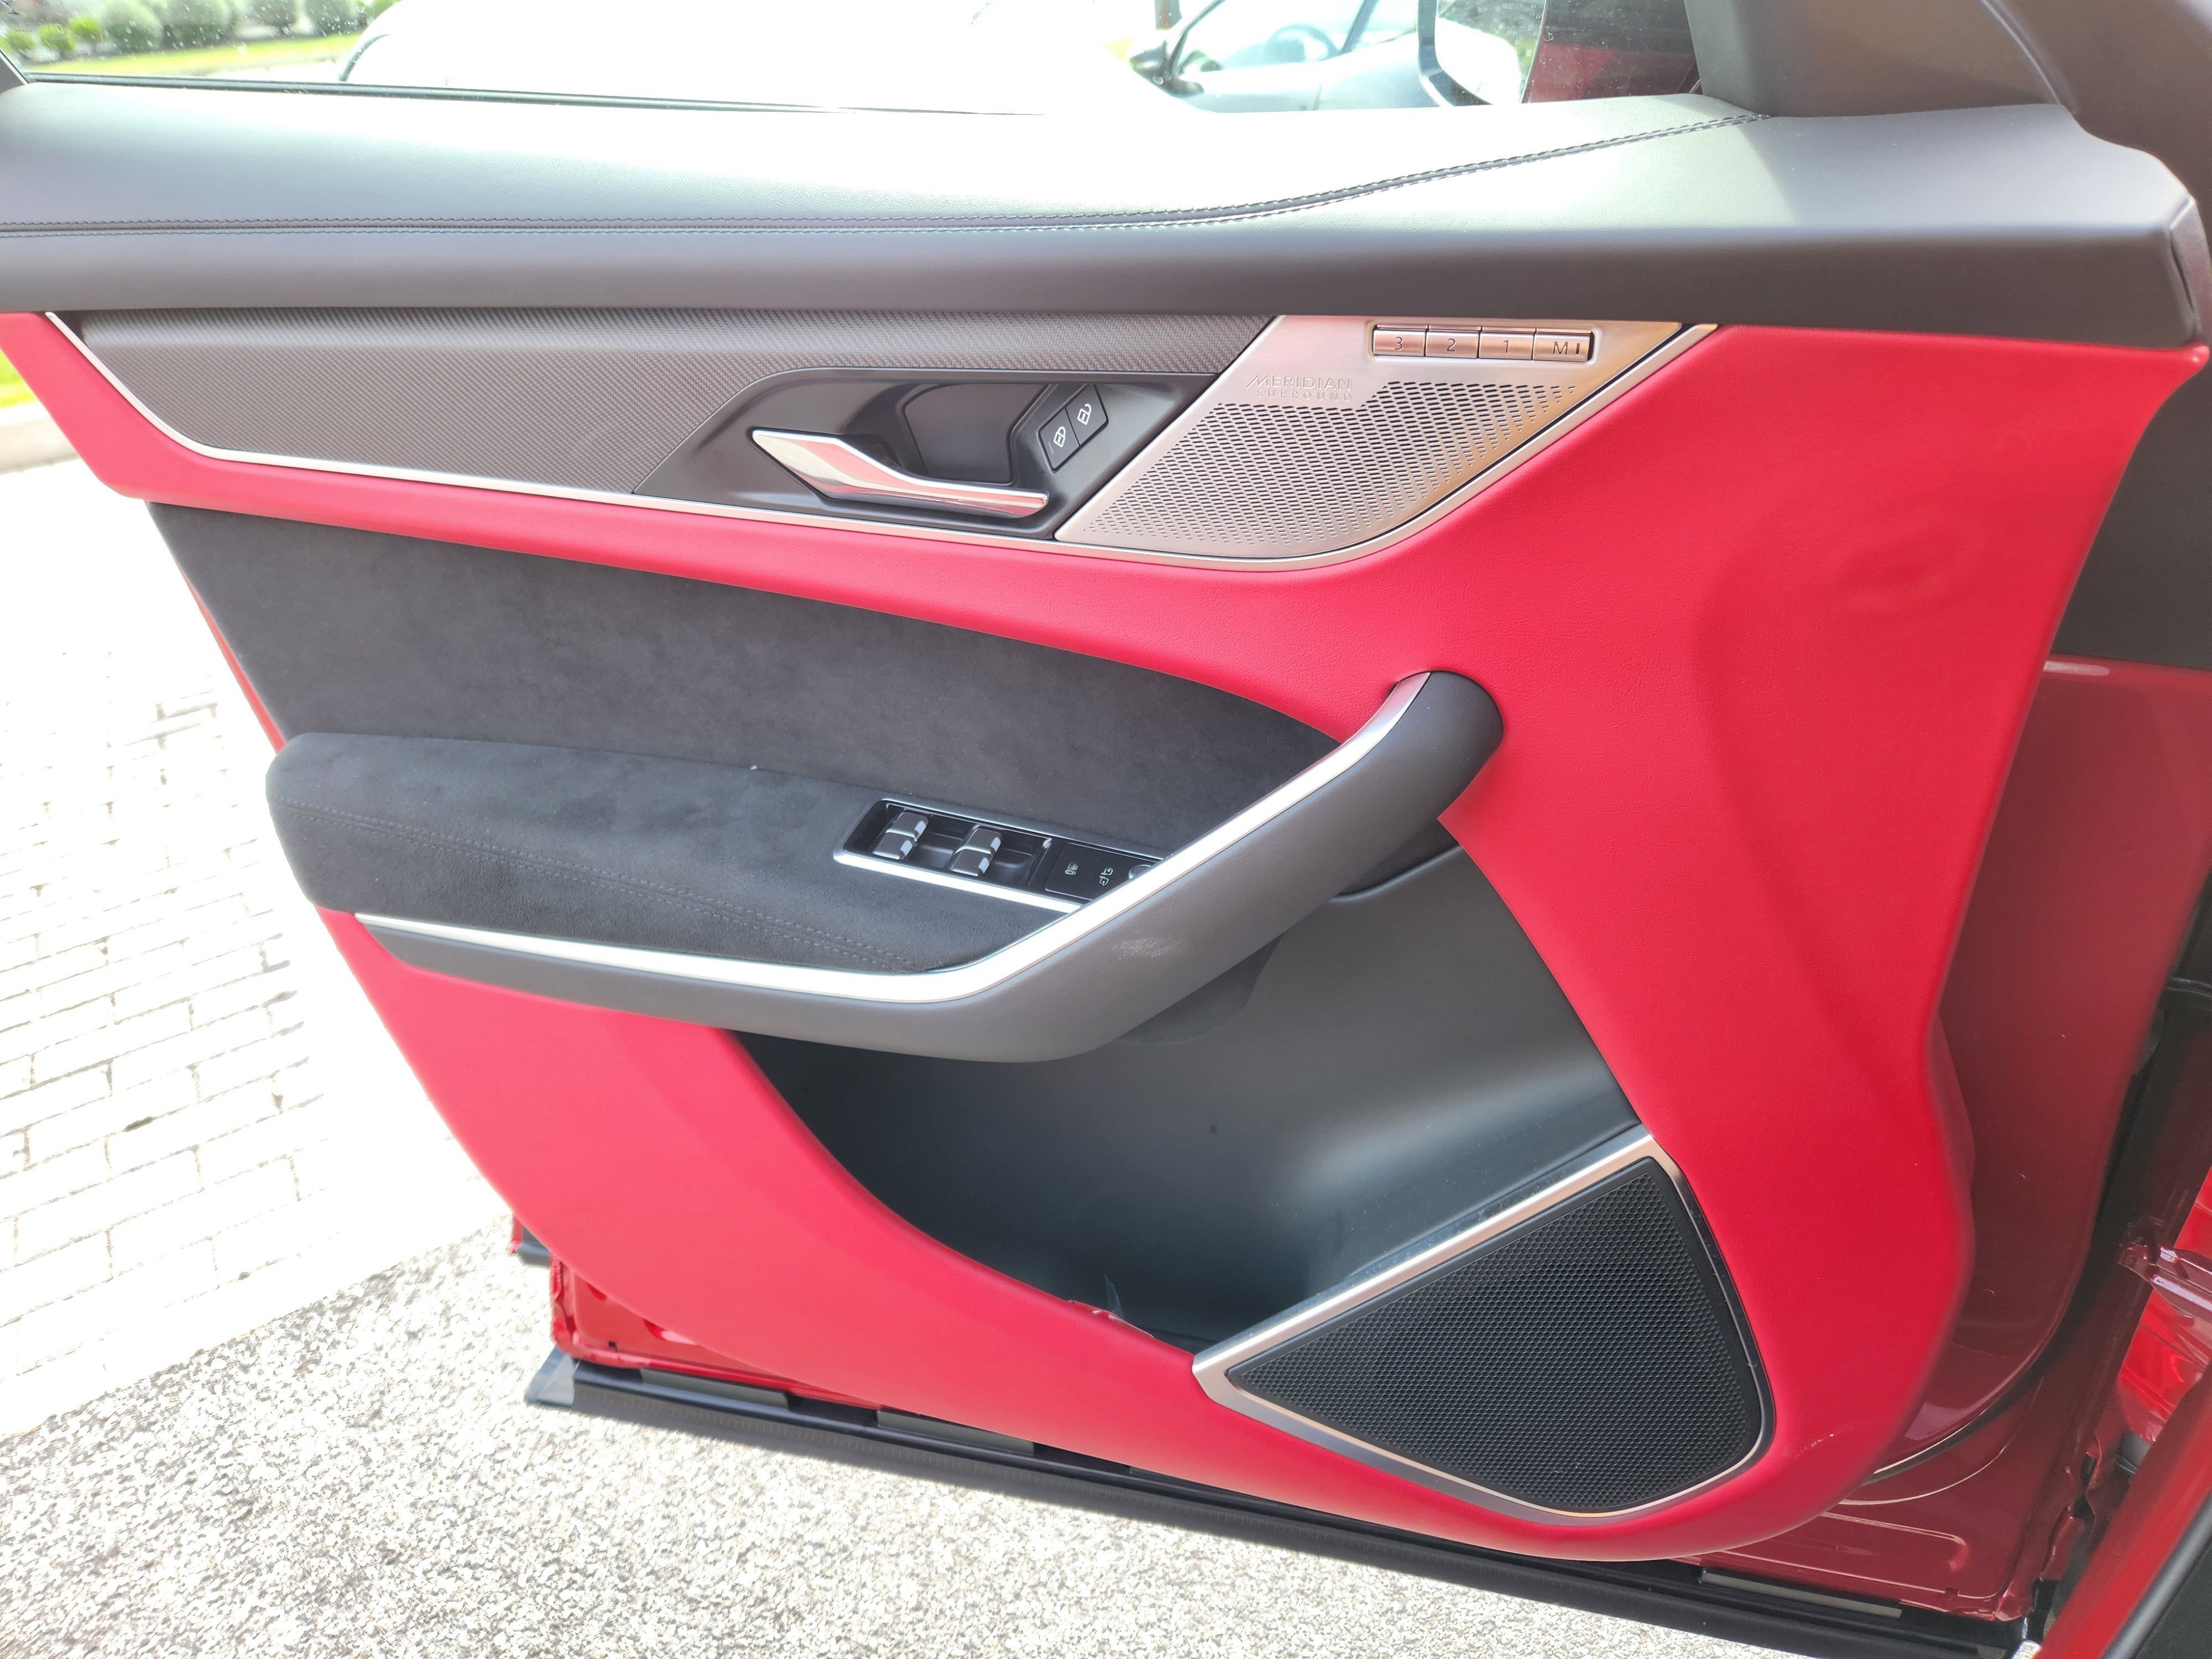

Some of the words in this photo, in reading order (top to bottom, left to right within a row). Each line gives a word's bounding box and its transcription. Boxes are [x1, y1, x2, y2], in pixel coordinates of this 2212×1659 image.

[1395, 336, 1403, 351] 3
[1447, 338, 1455, 352] 2
[1503, 340, 1509, 354] 1
[1245, 375, 1352, 392] MERIDIAN
[1256, 389, 1352, 403] SURROUND
